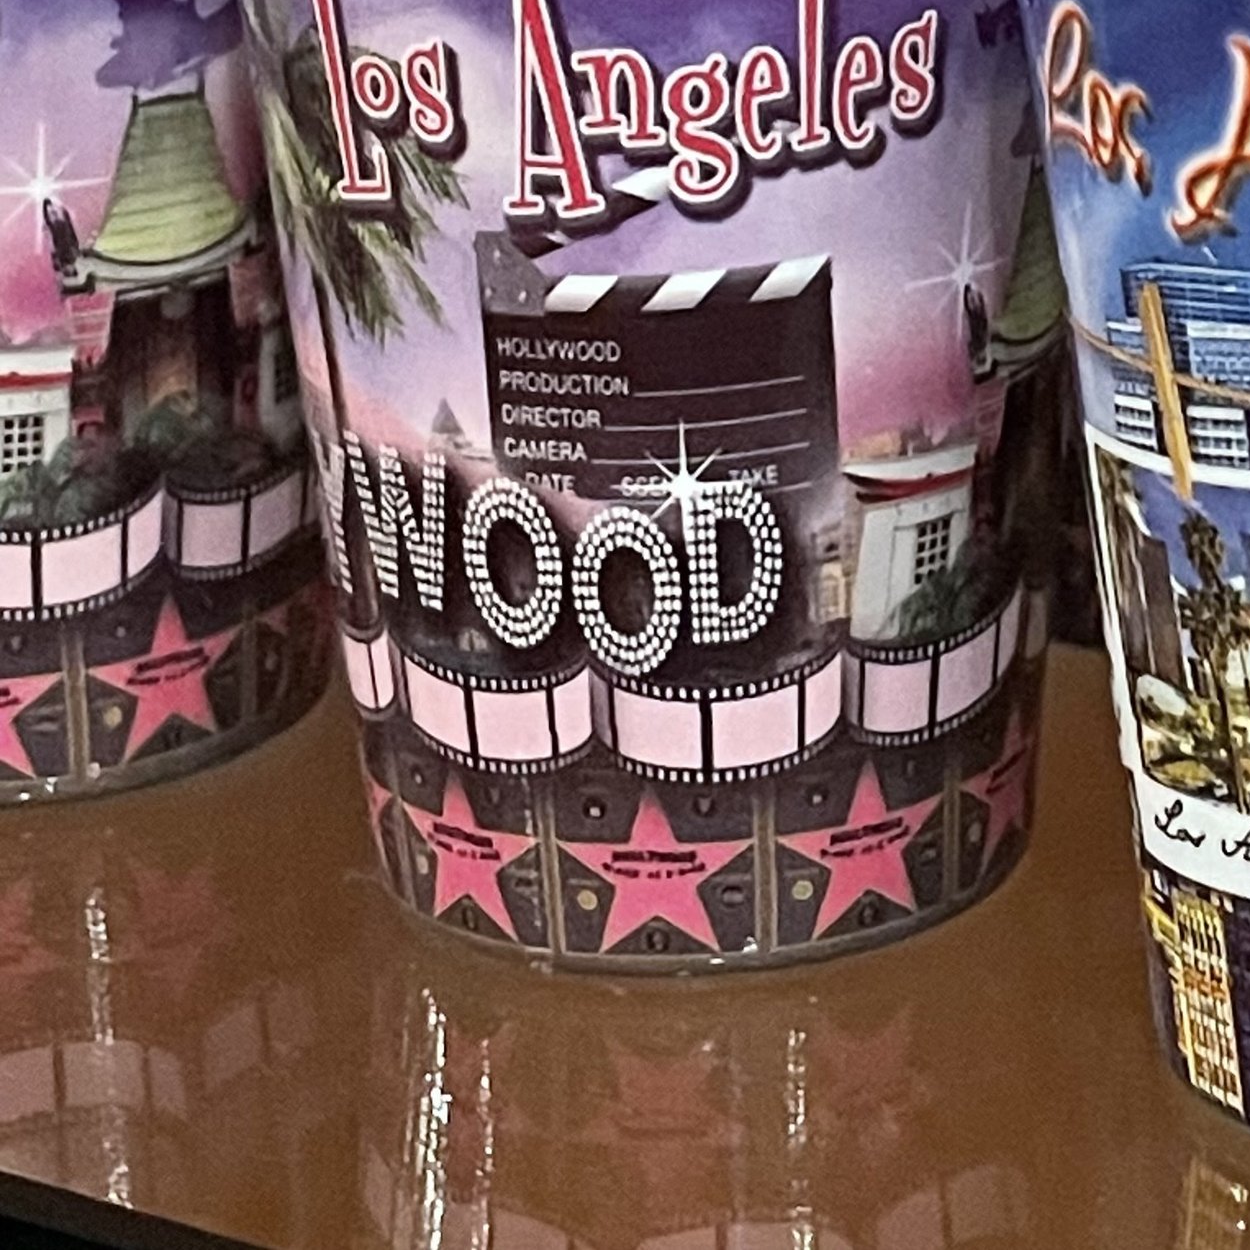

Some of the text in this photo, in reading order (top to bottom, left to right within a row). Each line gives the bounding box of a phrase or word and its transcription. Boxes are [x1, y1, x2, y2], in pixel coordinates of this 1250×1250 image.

[496, 336, 623, 363] HOLLYWOOD
[499, 369, 631, 397] PRODUCTION
[501, 403, 602, 428] DIRECTOR
[503, 437, 589, 463] CAMERA
[1154, 798, 1206, 848] Los
